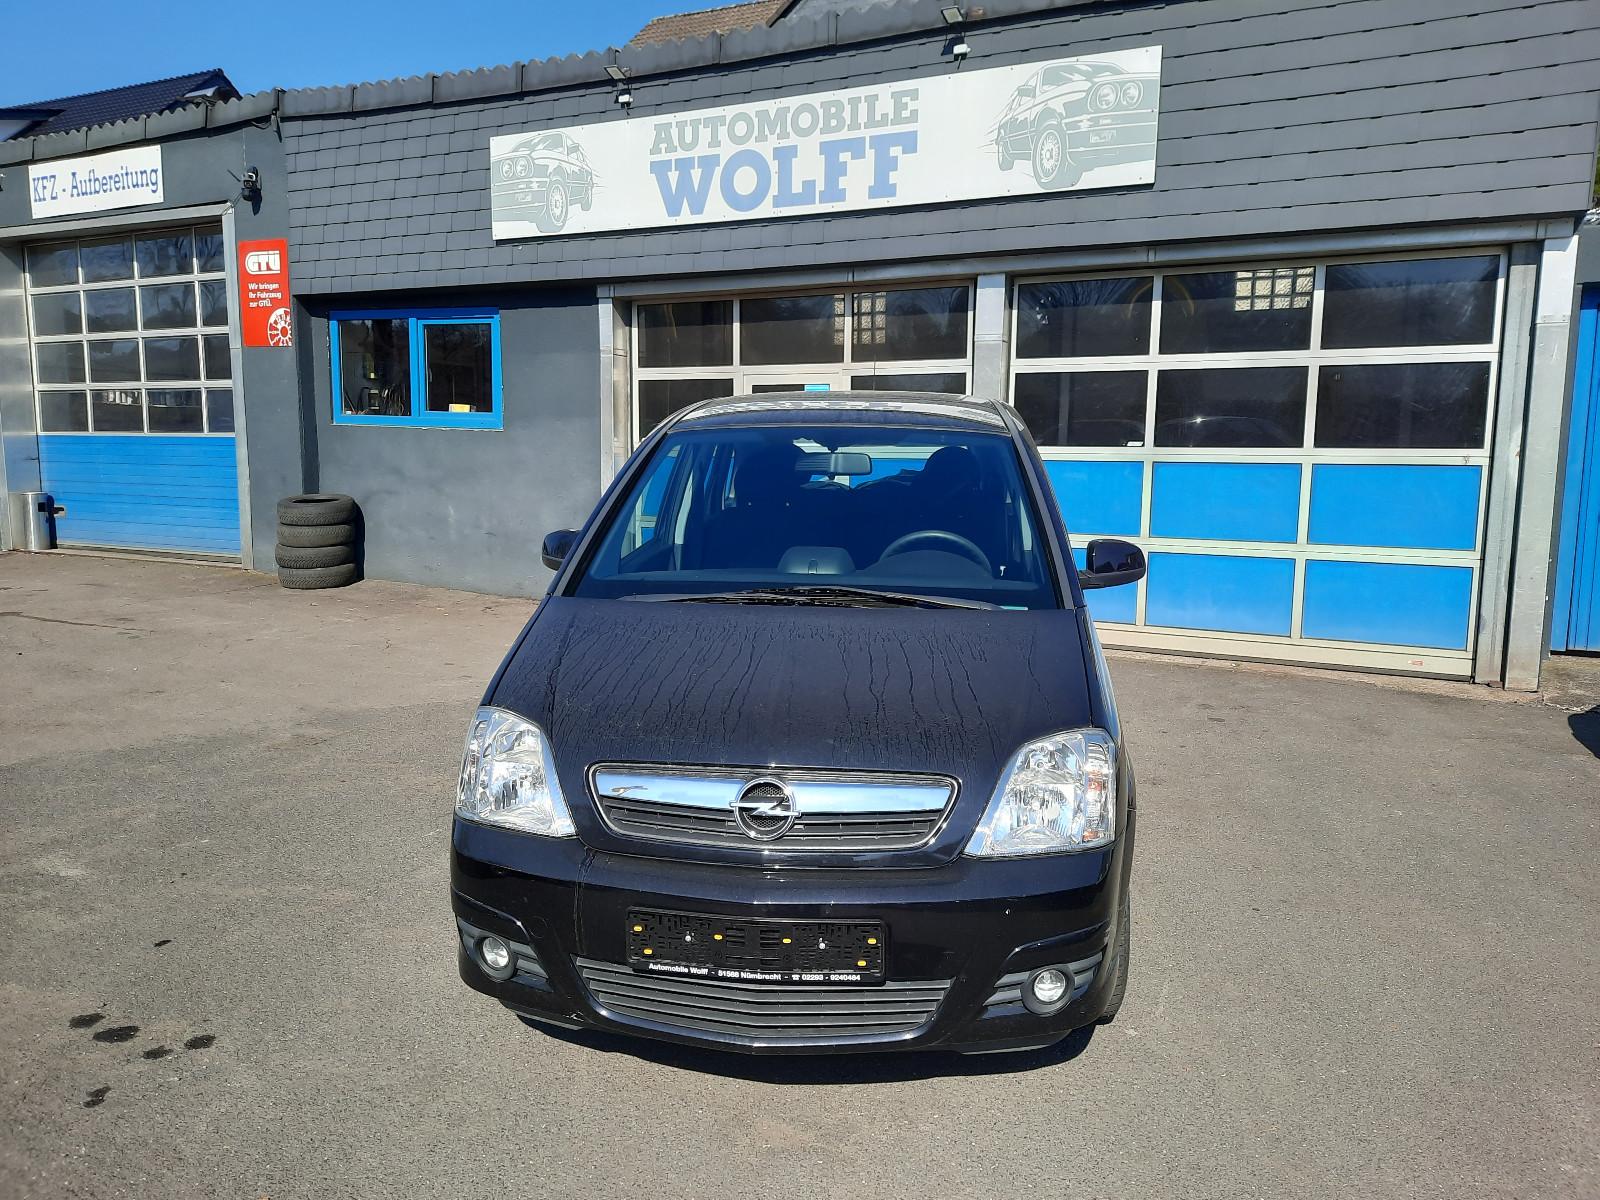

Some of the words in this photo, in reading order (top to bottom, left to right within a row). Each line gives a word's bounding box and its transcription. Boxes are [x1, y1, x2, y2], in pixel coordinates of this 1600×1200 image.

[649, 88, 919, 155] AUTOMOBILE
[32, 174, 58, 203] KFZ
[70, 165, 159, 198] Aufbereitung
[649, 130, 918, 218] WOLFF
[248, 283, 258, 291] Wir
[259, 282, 279, 291] bringen
[248, 291, 257, 299] Ihr
[257, 291, 282, 300] Fahrzeug
[648, 962, 689, 973] Automobile
[690, 967, 709, 976] Wolff
[740, 971, 782, 981] Nümbrecht
